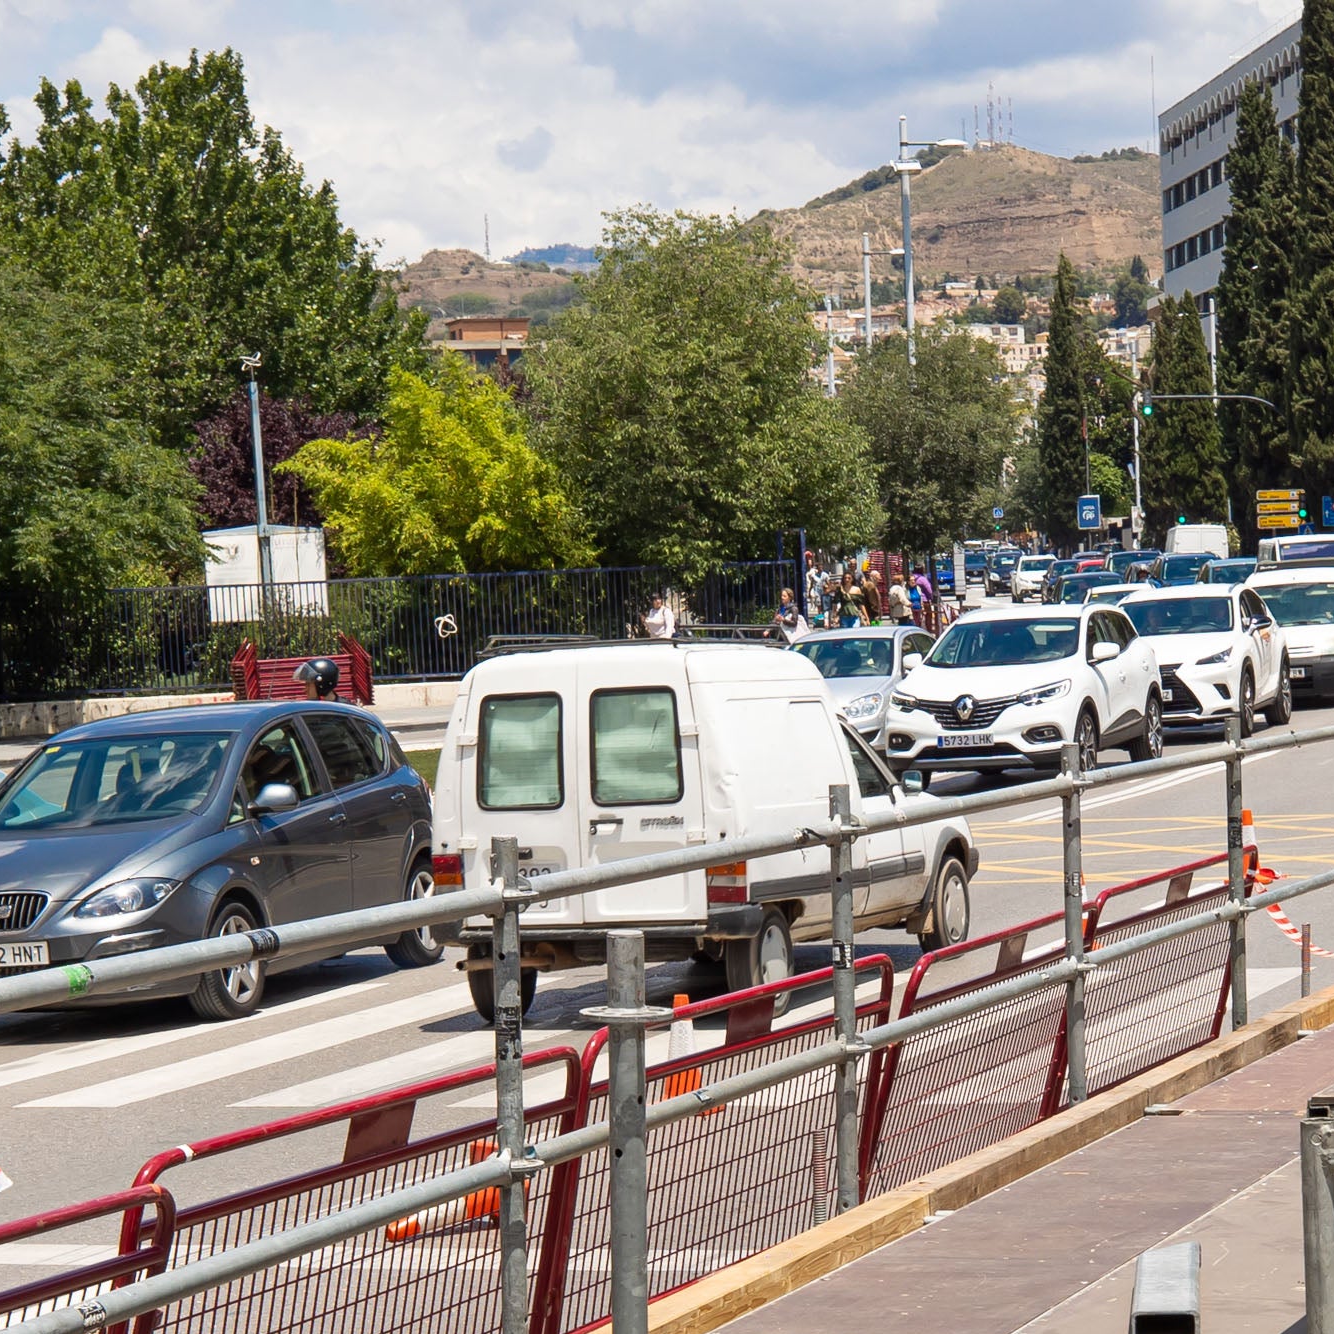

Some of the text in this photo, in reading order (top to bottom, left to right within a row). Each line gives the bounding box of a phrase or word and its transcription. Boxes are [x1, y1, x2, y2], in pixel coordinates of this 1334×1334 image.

[943, 734, 994, 746] 5732 LHK
[12, 945, 44, 963] HNT
